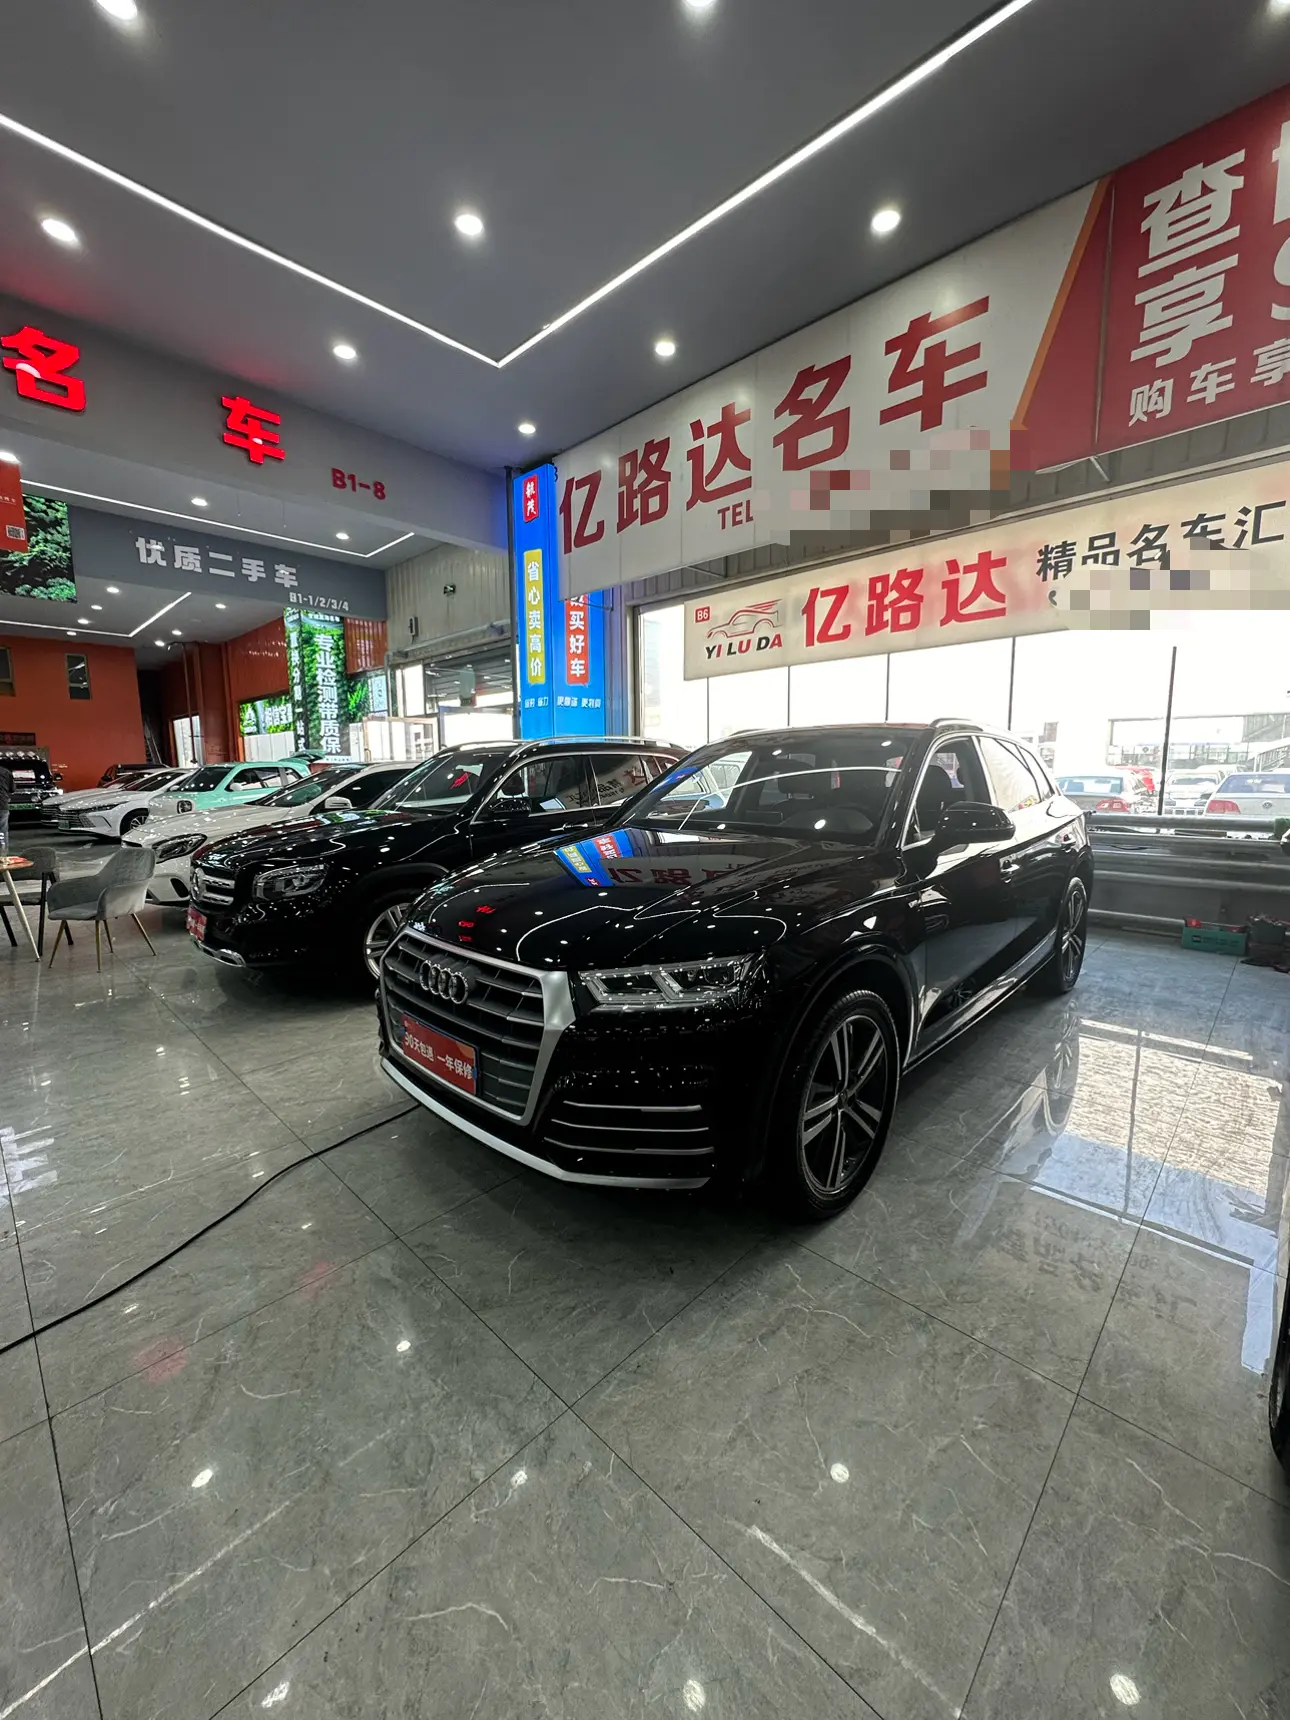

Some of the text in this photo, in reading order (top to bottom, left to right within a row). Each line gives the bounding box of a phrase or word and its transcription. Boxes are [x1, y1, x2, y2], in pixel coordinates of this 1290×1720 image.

[559, 295, 990, 555] 亿路达名车
[331, 467, 386, 500] B1-8
[135, 536, 298, 588] 优质二手车
[1036, 500, 1286, 581] 精品名车汇
[289, 591, 350, 611] B1-1/2/3/4
[527, 561, 544, 677] 省心卖高价
[697, 608, 709, 621] B6
[801, 550, 1007, 647] 亿路达
[705, 633, 782, 659] YI LU DA
[313, 634, 342, 754] 专业检测带质保
[437, 1053, 473, 1080] 一年保修
